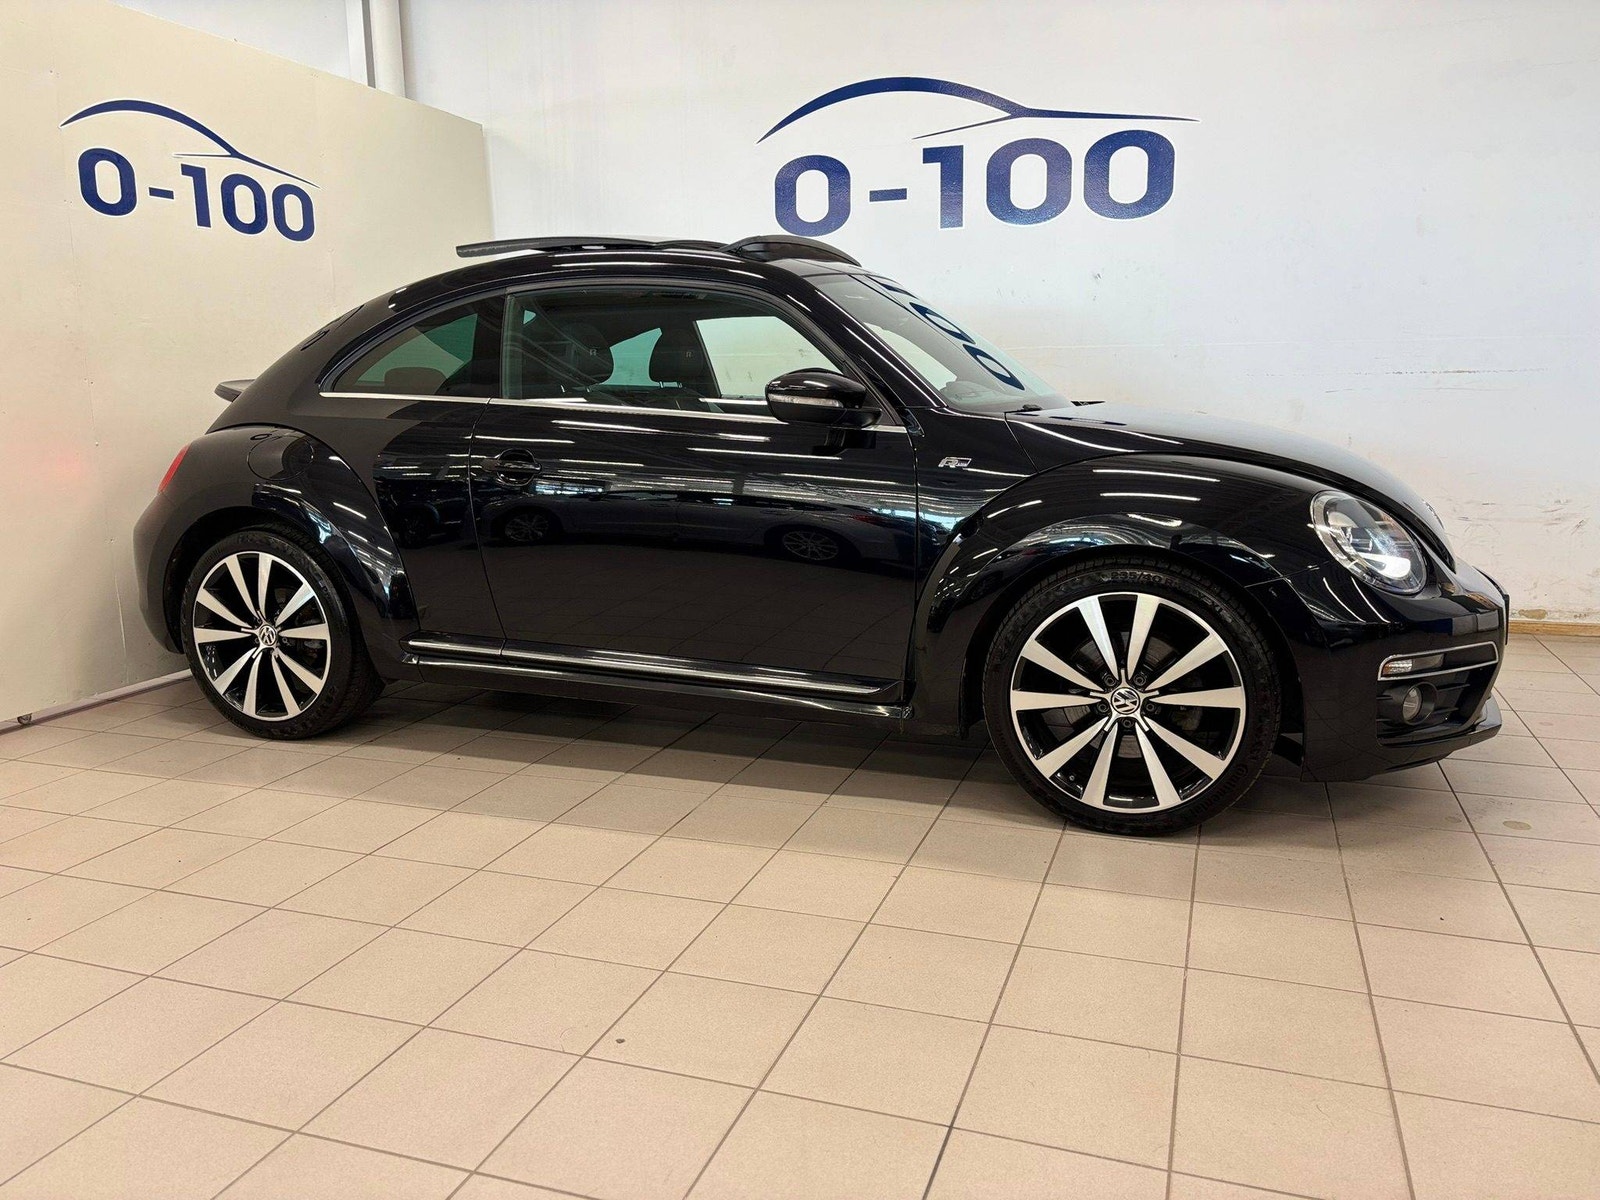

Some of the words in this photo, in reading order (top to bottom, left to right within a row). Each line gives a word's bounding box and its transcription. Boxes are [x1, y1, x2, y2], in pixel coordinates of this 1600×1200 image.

[77, 147, 315, 242] 0-100
[774, 129, 1176, 238] 0-100
[1110, 570, 1164, 584] 235/40
